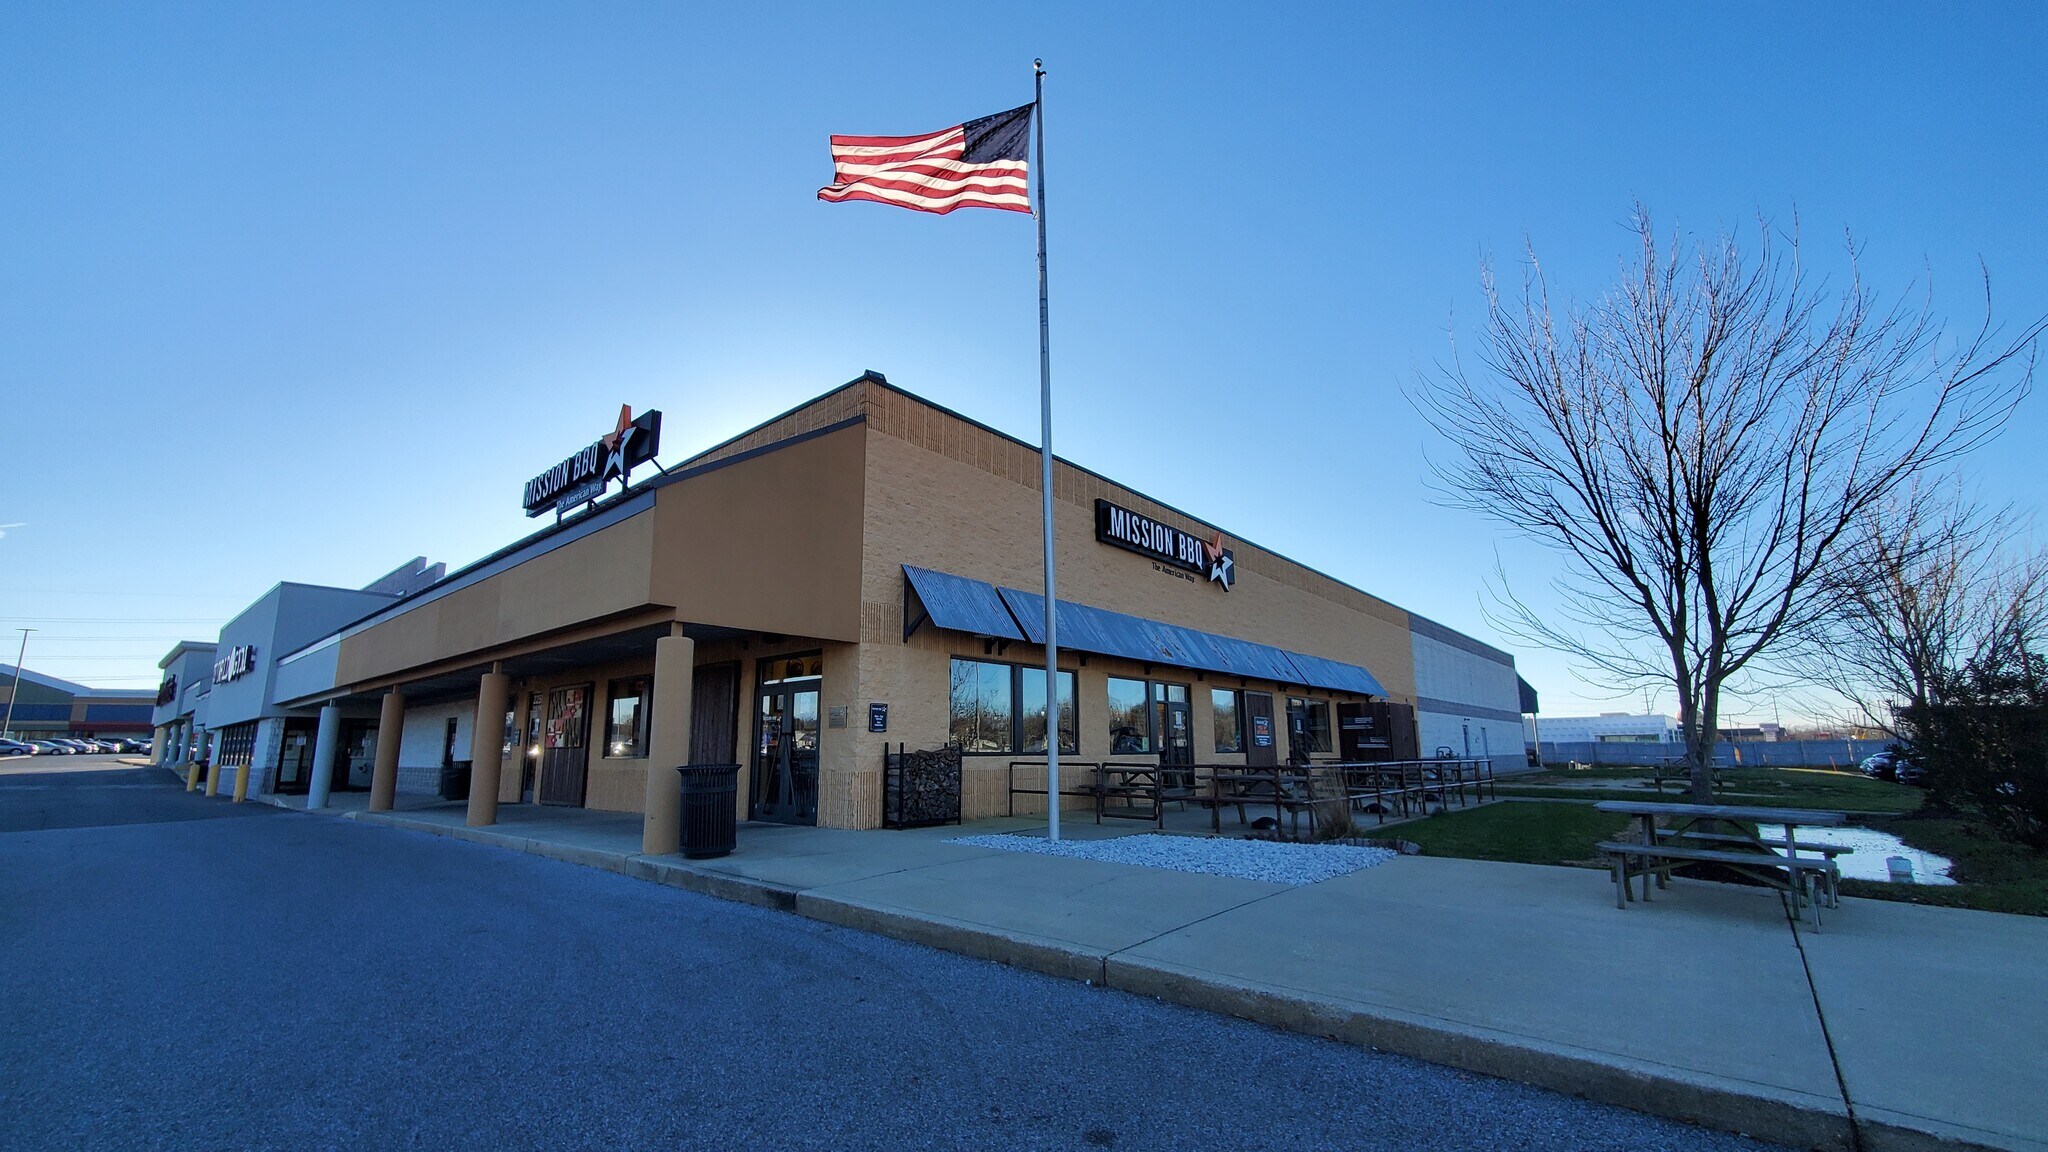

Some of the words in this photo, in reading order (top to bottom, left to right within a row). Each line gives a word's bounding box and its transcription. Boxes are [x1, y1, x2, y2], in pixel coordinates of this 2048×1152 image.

[525, 458, 570, 507] MISSION
[573, 442, 598, 481] BBQ
[1110, 506, 1173, 557] MISSION
[1179, 533, 1203, 570] BBQ
[1162, 565, 1184, 580] American
